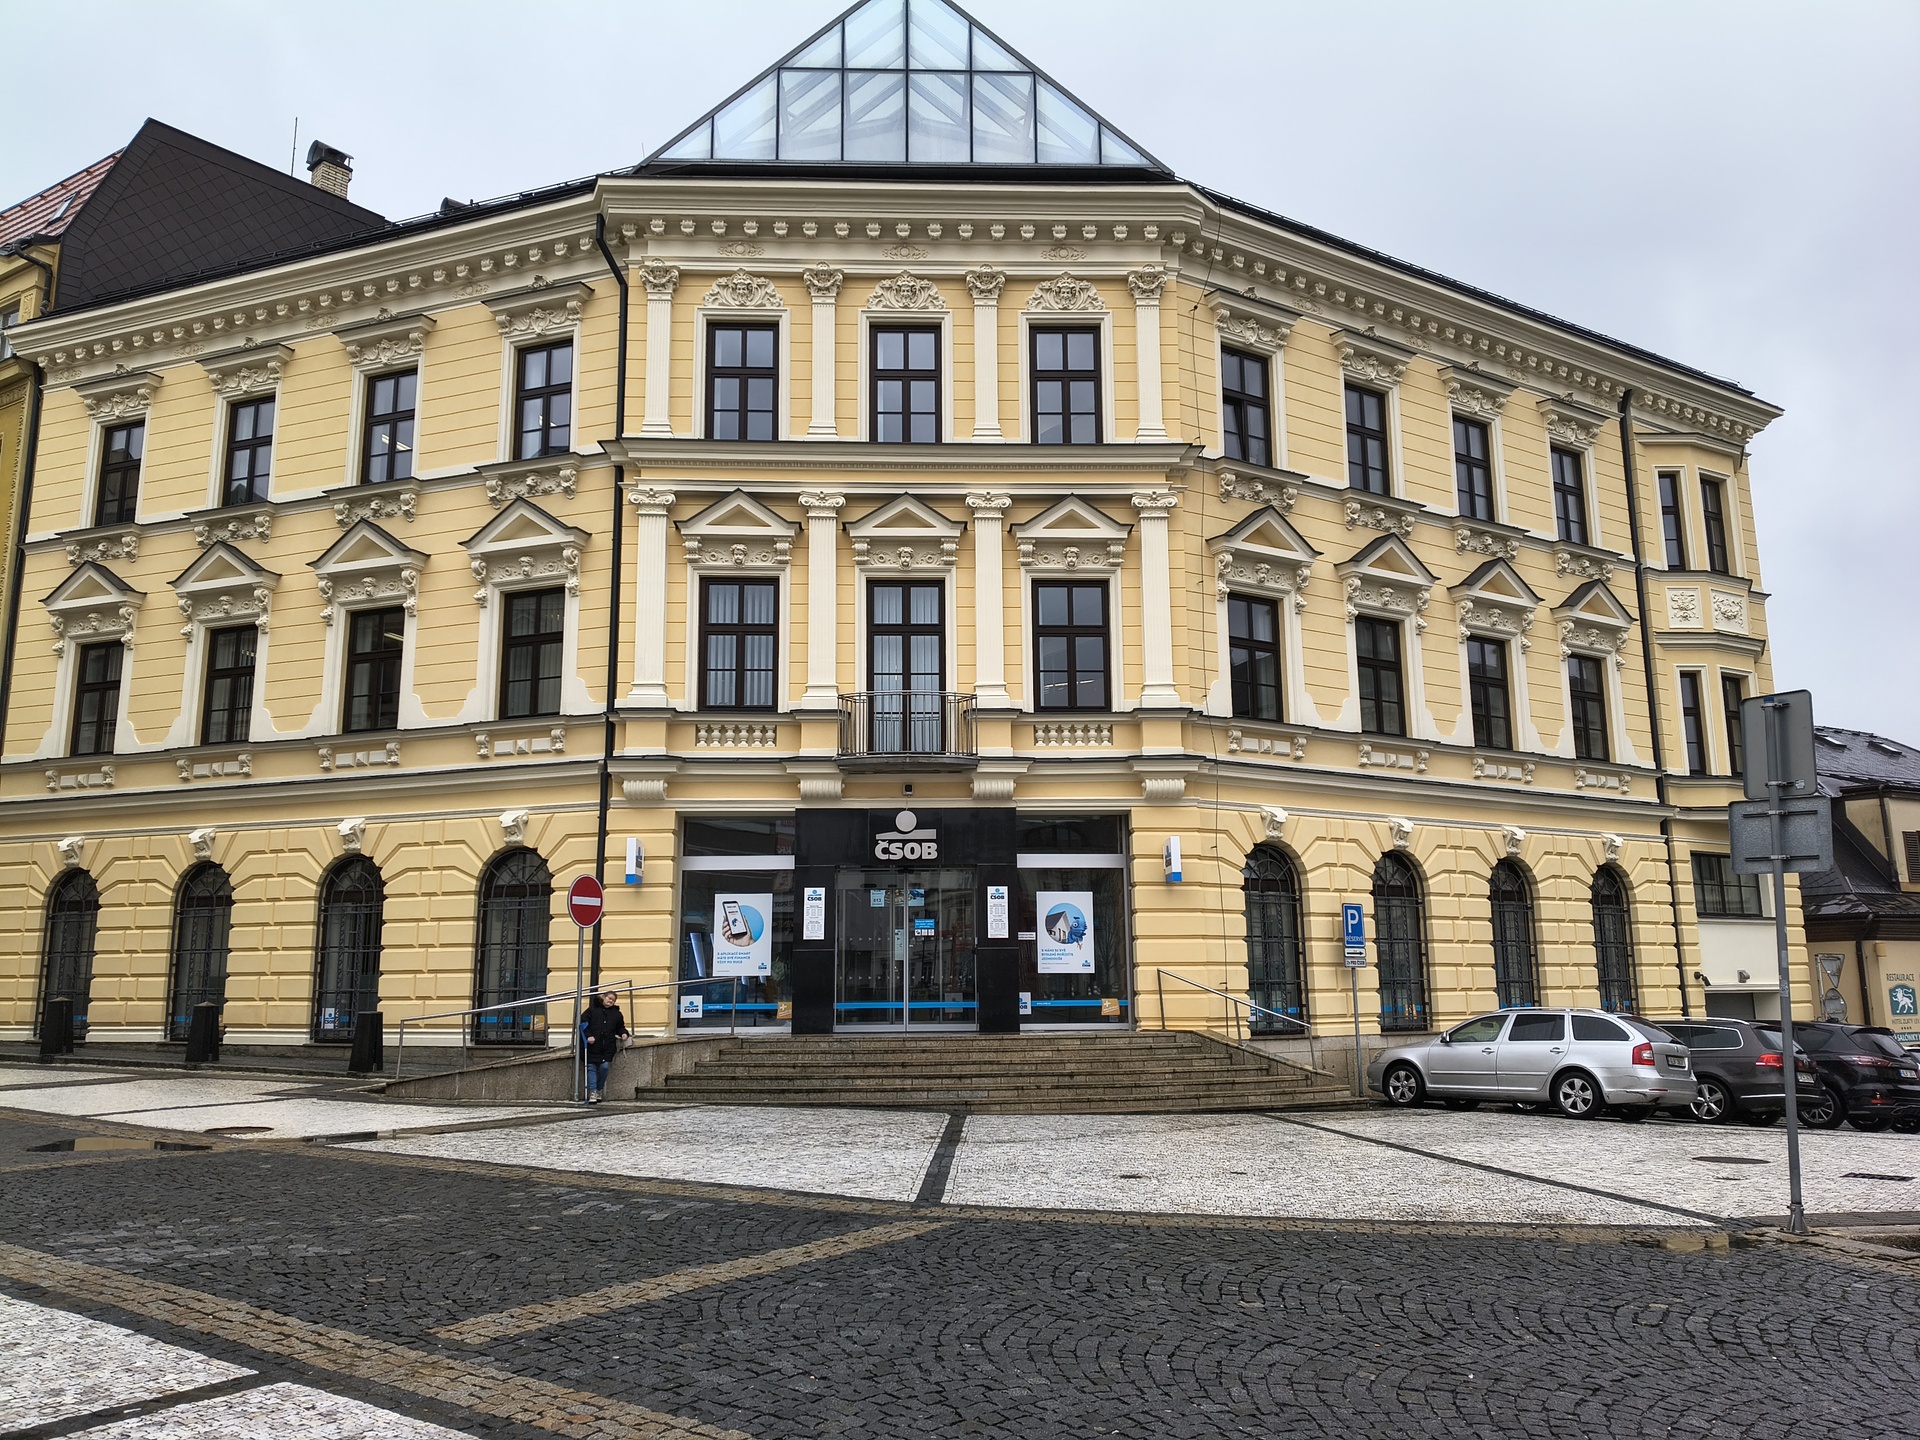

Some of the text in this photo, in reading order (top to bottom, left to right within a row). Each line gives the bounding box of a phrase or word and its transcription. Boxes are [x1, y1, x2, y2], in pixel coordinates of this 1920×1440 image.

[874, 840, 938, 860] ČSOB
[1348, 910, 1359, 933] P
[1886, 974, 1915, 982] RESTAURACE
[1897, 1033, 1918, 1041] SALÓNKY
